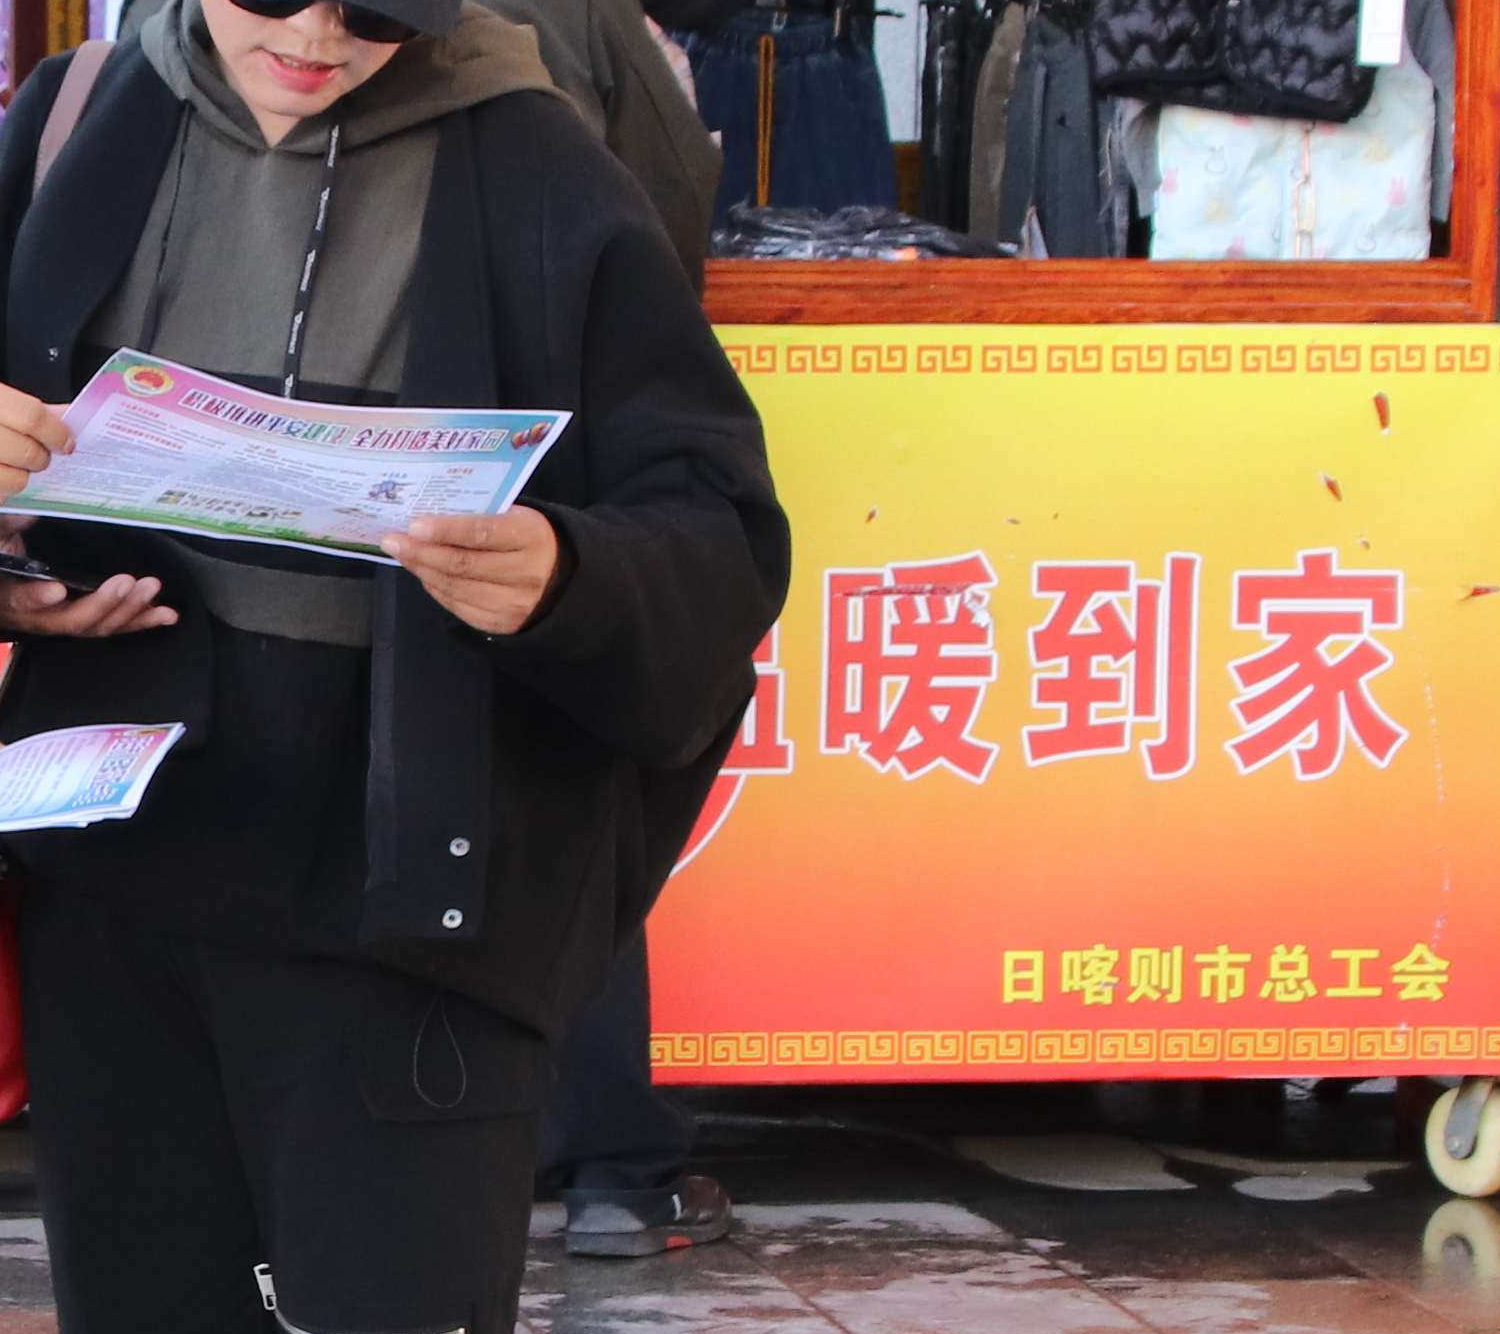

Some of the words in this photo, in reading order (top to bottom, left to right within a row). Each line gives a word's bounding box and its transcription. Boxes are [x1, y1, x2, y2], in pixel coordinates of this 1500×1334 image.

[1001, 943, 1450, 1005] 日喀则市总工会
